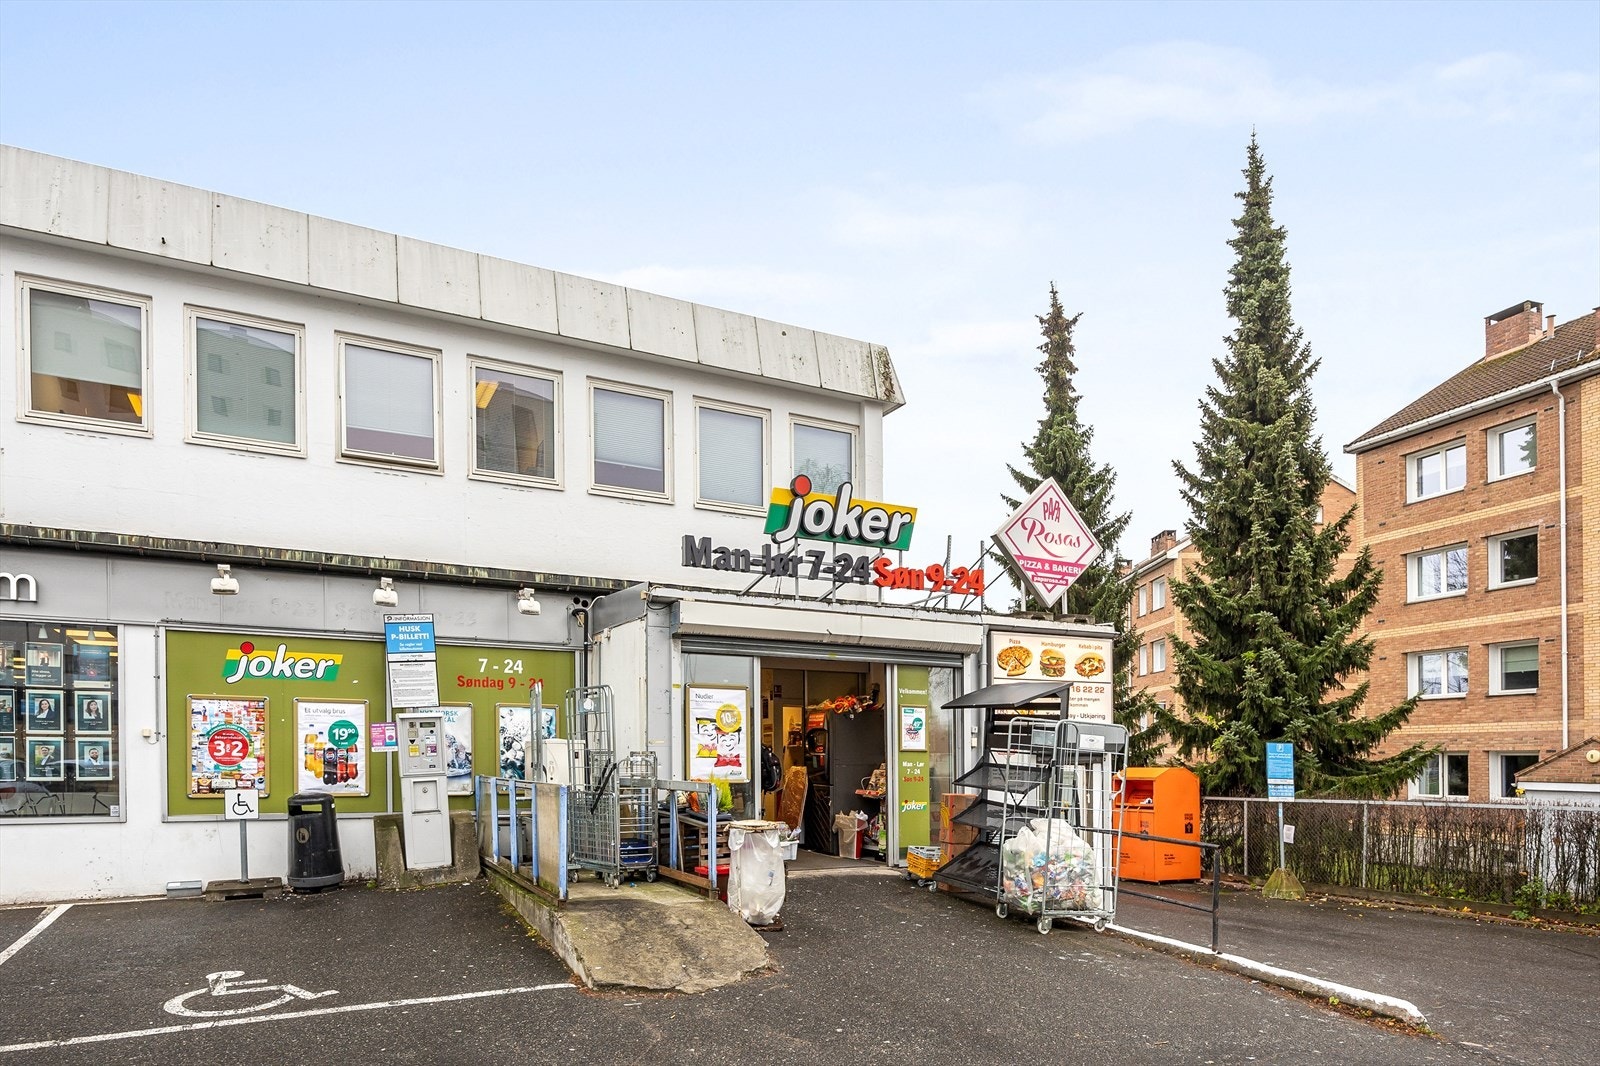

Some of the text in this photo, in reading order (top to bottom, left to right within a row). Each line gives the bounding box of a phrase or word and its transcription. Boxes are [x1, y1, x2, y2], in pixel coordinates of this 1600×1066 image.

[771, 474, 913, 544] joker
[1042, 497, 1061, 523] PAPA
[1020, 517, 1081, 558] Rosas
[682, 535, 985, 596] Man-lør 7-24 Søn 9-24
[1019, 559, 1082, 574] PIZZA & BAKERI
[1033, 576, 1067, 585] paparosa.no
[399, 625, 421, 633] HUSK
[225, 641, 335, 684] joker
[478, 658, 488, 673] 7
[504, 659, 523, 674] 24
[457, 675, 504, 690] Søndag
[508, 677, 516, 688] 9
[1094, 686, 1105, 694] 22
[213, 740, 226, 756] 3
[231, 740, 244, 756] 2
[902, 799, 925, 812] joker
